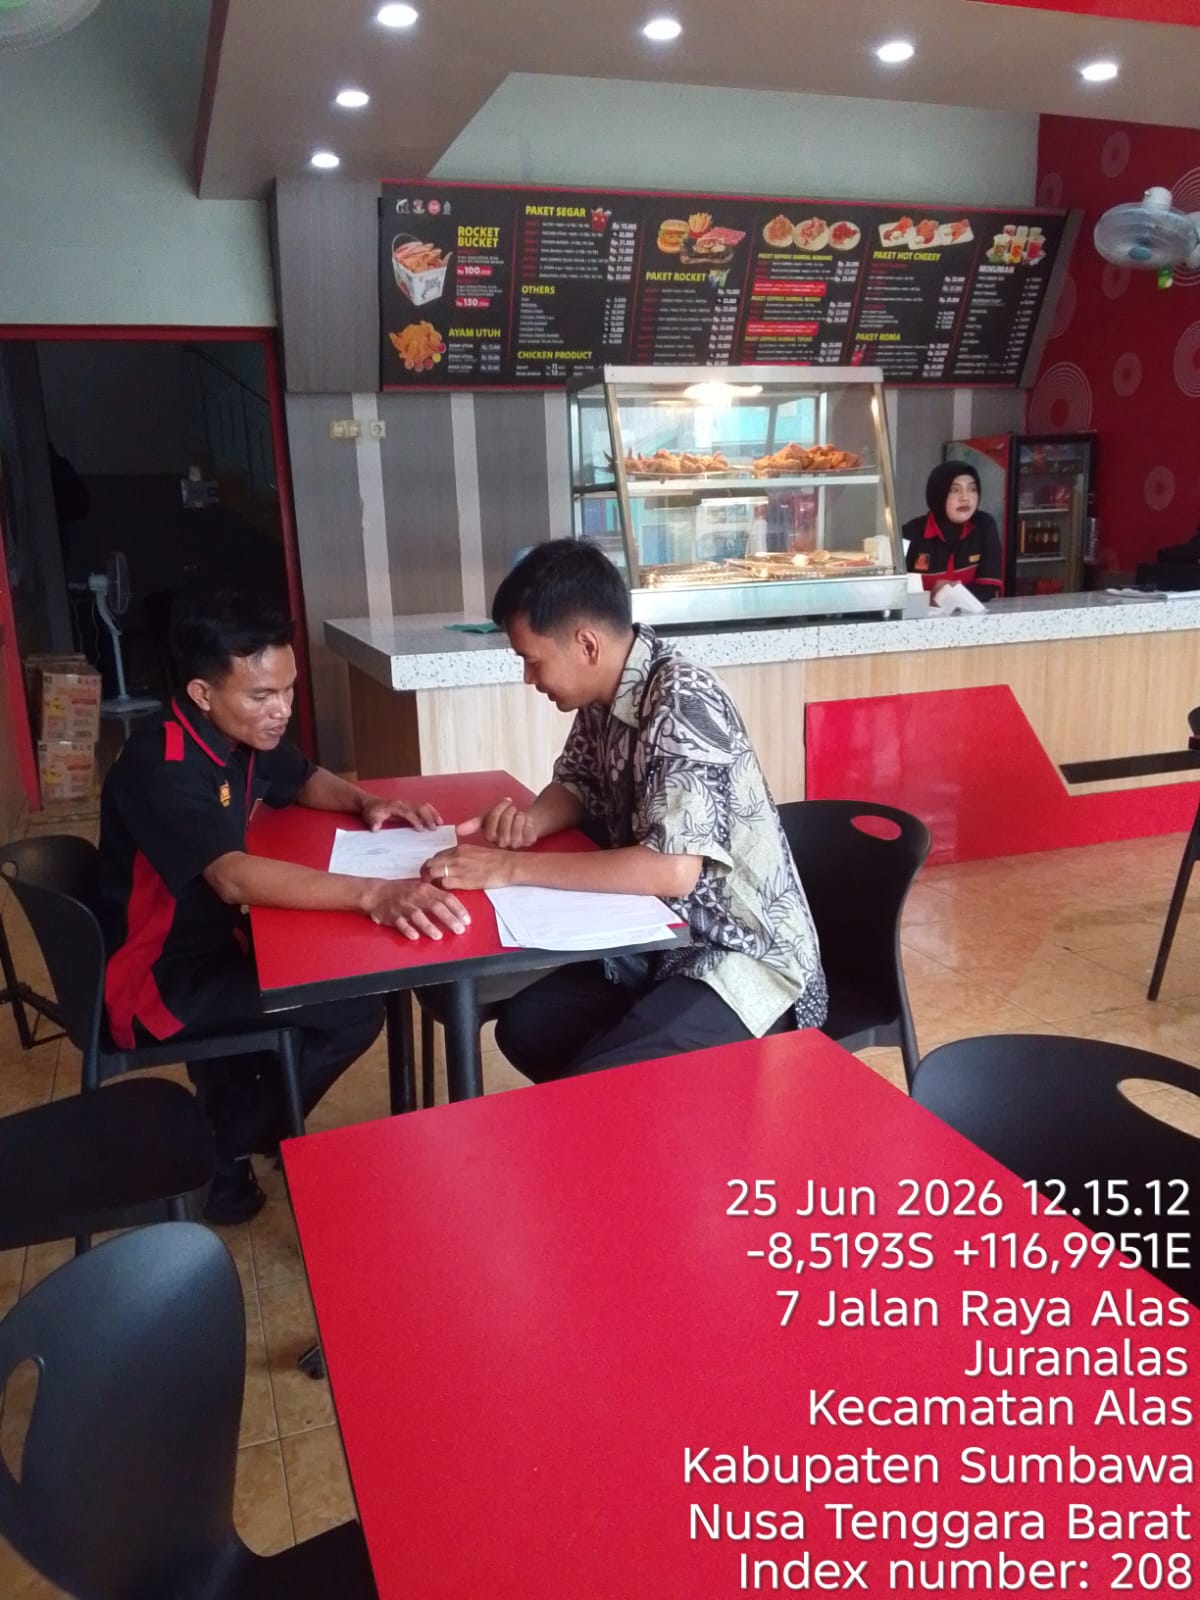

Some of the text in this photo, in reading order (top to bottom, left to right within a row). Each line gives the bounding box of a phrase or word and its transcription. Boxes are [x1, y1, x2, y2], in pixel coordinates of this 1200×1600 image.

[525, 205, 586, 217] PAKET SEGAR
[457, 226, 500, 237] ROCKET
[457, 237, 499, 247] BUCKET
[873, 251, 896, 259] PAKET
[897, 252, 913, 260] HOT
[979, 265, 1015, 274] MINUMAN
[646, 272, 706, 282] PAKET ROCKET
[521, 285, 555, 294] OTHERS
[448, 328, 501, 337] AYAM UTUH
[856, 333, 878, 341] PAKET
[517, 351, 592, 359] CHICKEN PRODUCT
